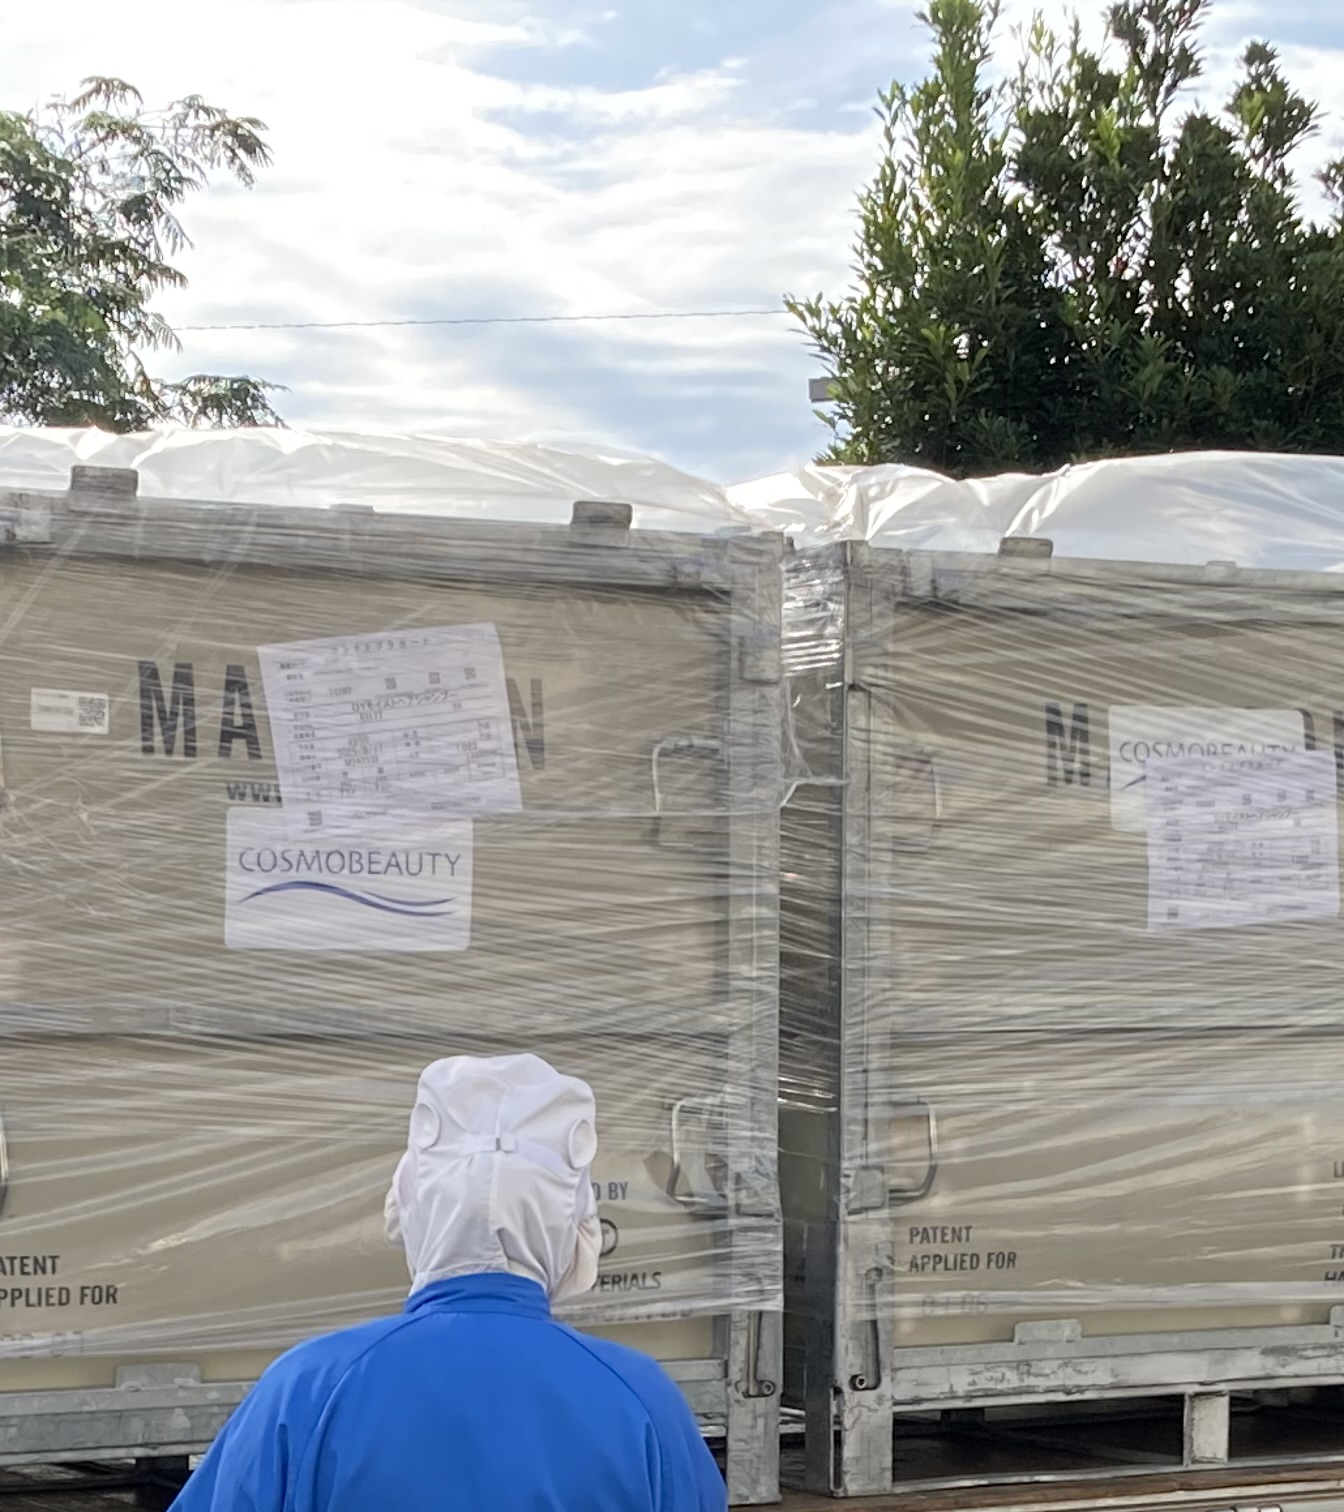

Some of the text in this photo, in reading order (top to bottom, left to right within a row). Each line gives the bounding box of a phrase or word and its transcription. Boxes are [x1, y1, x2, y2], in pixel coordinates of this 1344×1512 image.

[238, 847, 462, 877] COSMOBEAUTY
[608, 1181, 629, 1200] BY
[908, 1225, 974, 1244] PATENT
[908, 1251, 1018, 1273] APPLIED FOR
[79, 1284, 119, 1306] FOR
